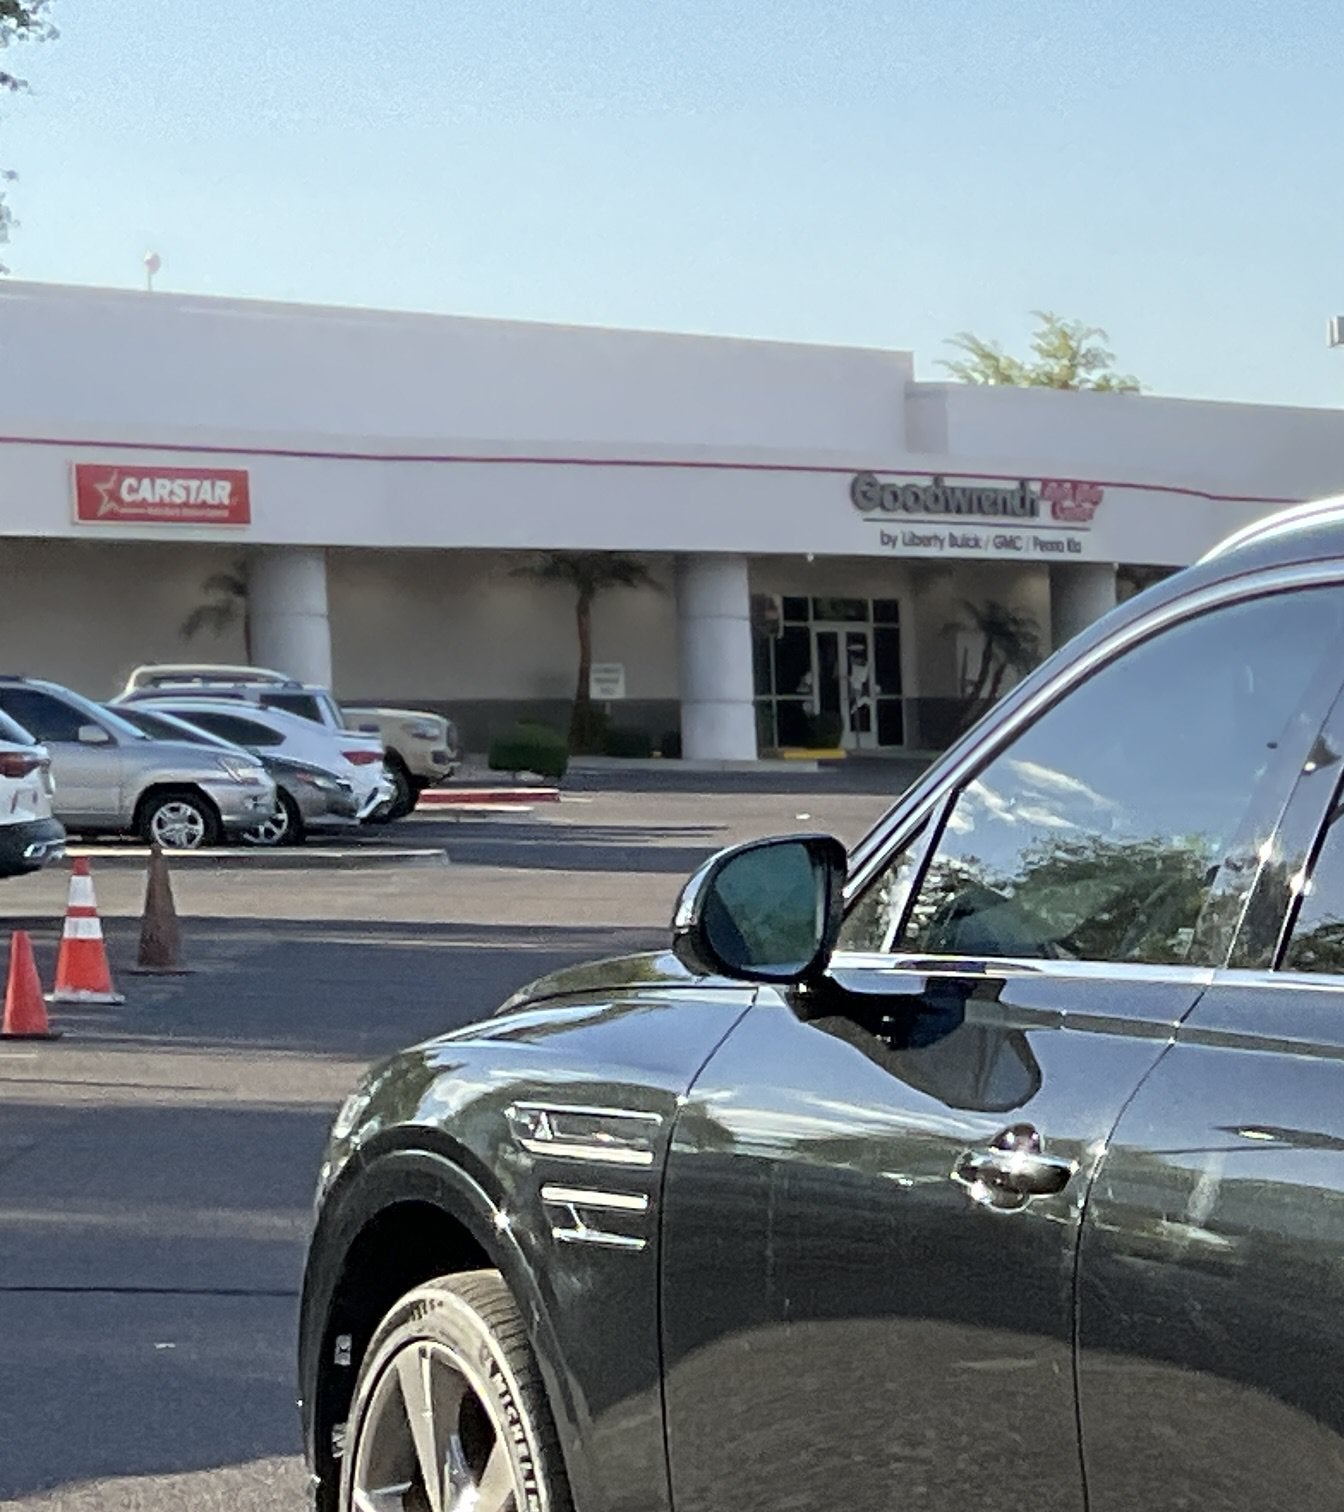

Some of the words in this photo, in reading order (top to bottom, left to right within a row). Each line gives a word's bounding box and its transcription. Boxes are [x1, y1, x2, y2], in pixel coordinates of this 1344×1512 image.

[120, 477, 232, 505] CARSTAR
[851, 473, 1040, 517] Goodwrench
[880, 530, 898, 549] by
[901, 531, 945, 551] Liberty
[993, 535, 1023, 551] GMC
